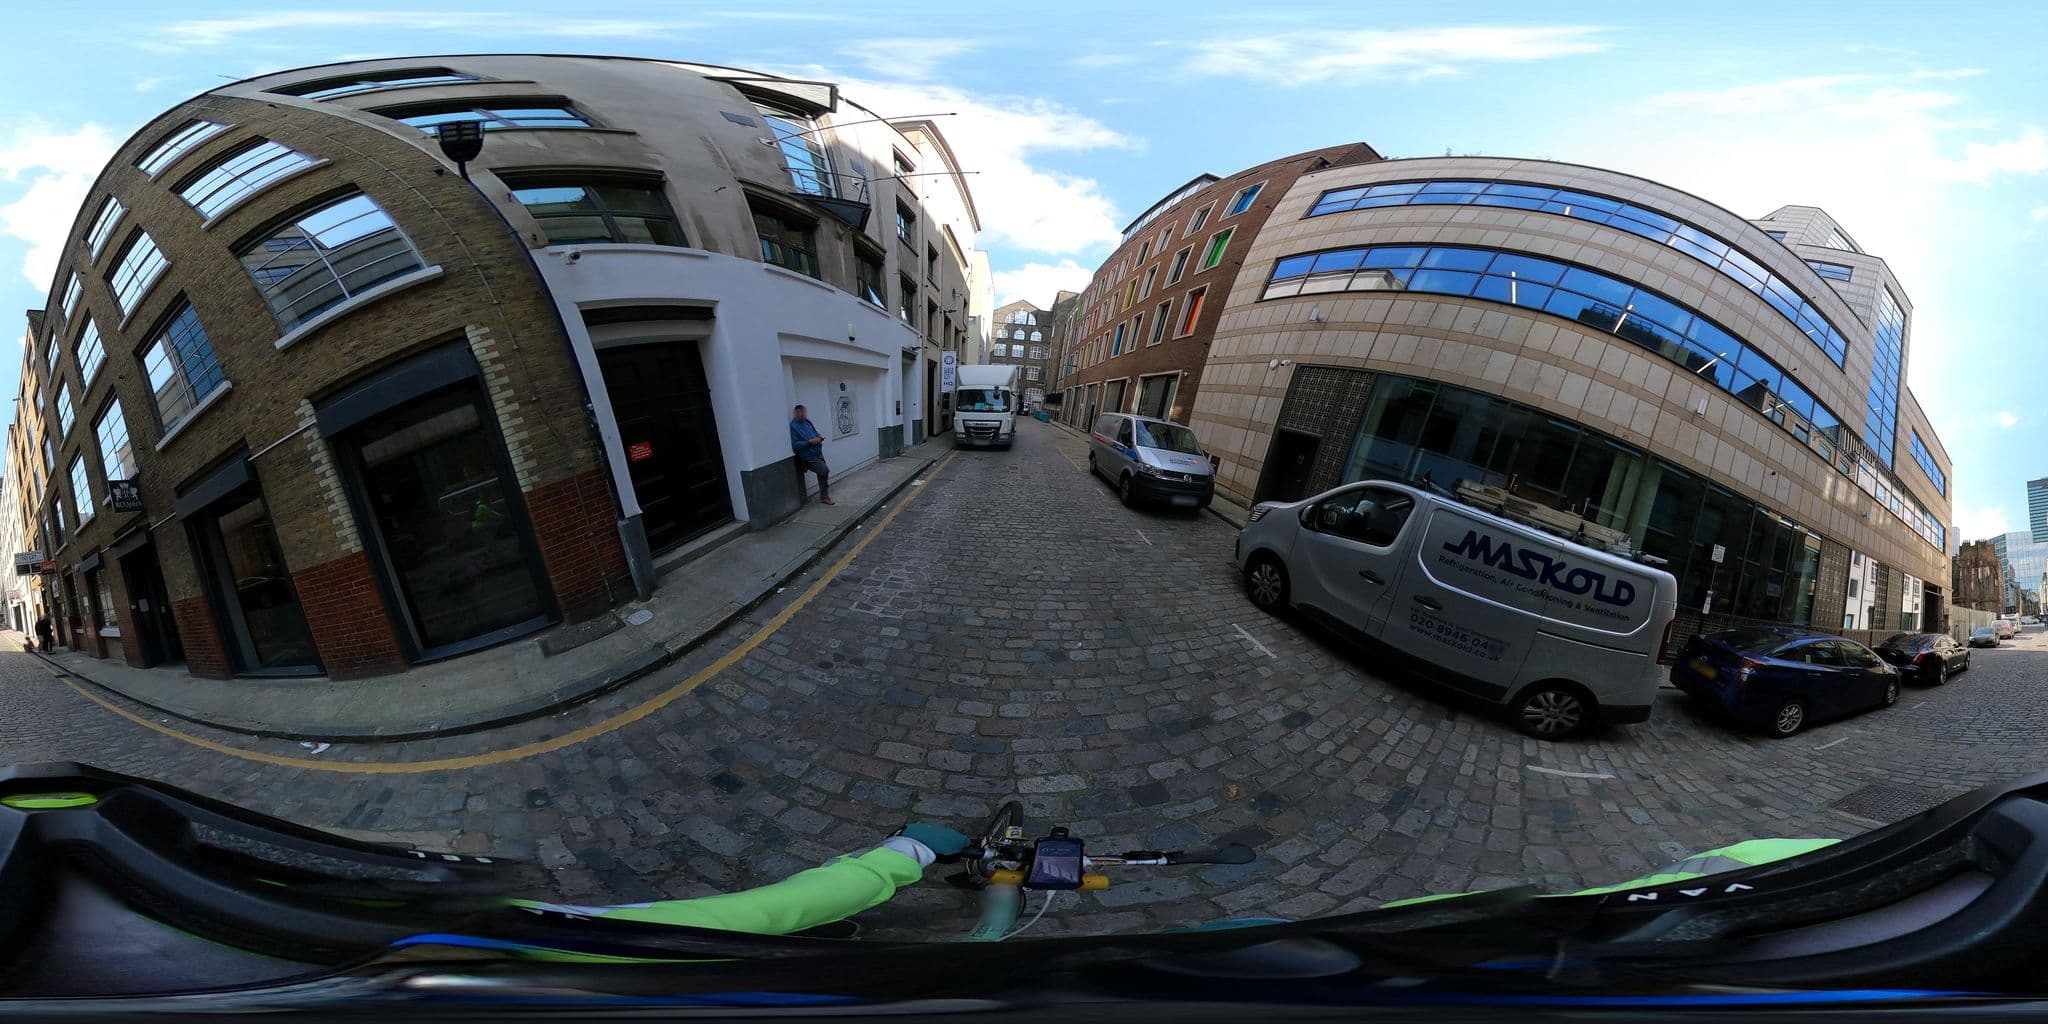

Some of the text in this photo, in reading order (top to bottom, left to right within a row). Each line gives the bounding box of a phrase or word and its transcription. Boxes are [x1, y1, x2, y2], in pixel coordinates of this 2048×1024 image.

[1438, 555, 1630, 621] Refrigeration, Air Conditioning & Ventilation
[1443, 529, 1635, 606] MASKOLD
[1410, 614, 1434, 629] 020
[1437, 624, 1469, 642] 8946
[1410, 624, 1502, 663] www.maskold.co.uk
